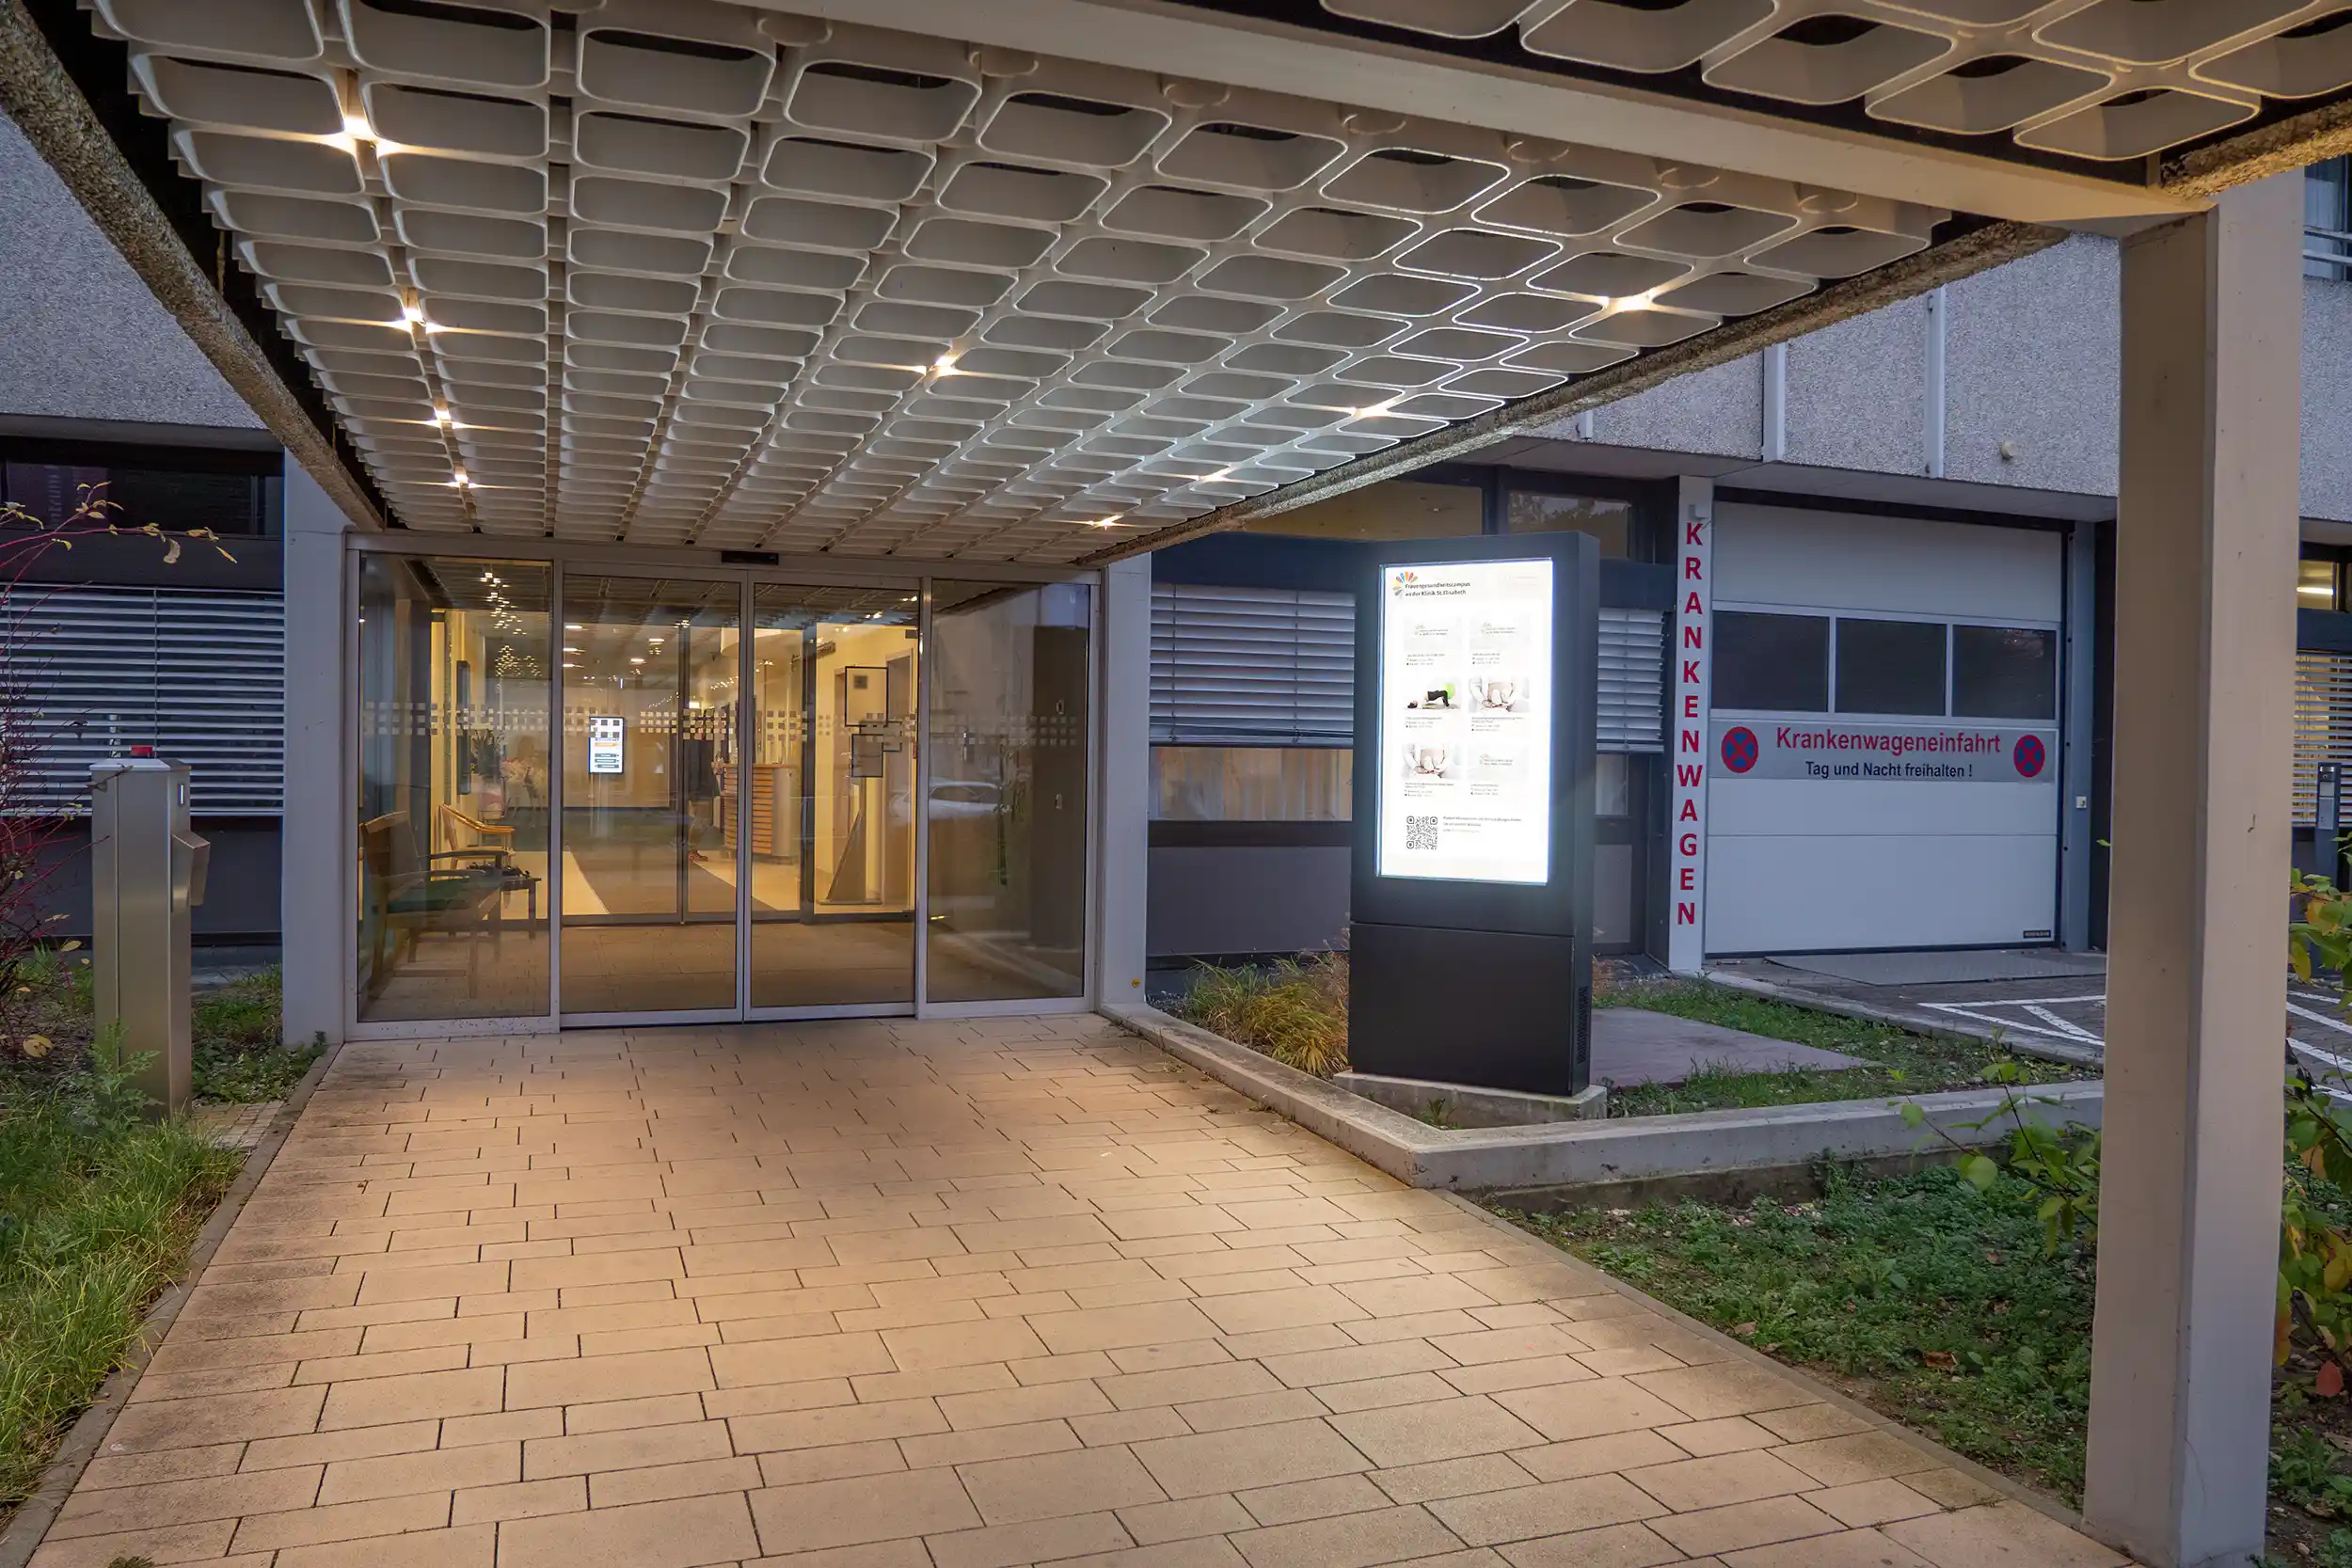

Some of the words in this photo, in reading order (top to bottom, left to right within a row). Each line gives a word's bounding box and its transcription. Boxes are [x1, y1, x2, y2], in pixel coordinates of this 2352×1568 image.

[1677, 522, 1704, 925] KRANKENWAGEN
[1776, 727, 2001, 756] Krankenwageneinfahrt
[1805, 761, 1829, 779] Tag
[1834, 762, 1859, 776] und
[1864, 763, 1901, 777] Nacht
[1905, 763, 1964, 778] freihalten
